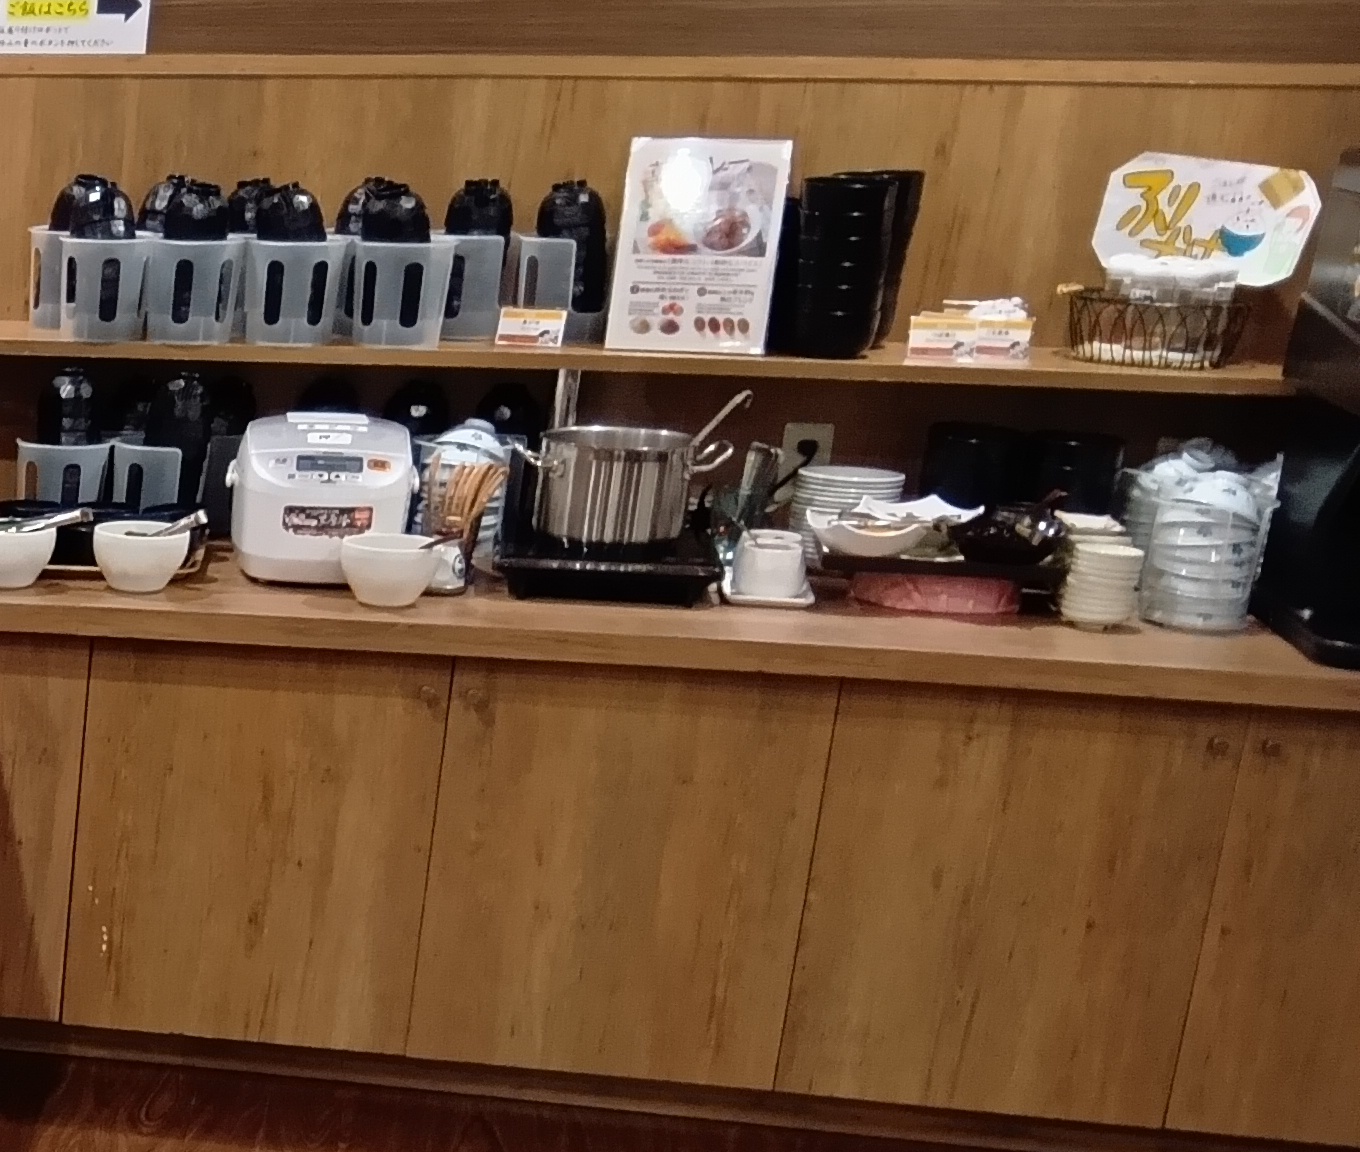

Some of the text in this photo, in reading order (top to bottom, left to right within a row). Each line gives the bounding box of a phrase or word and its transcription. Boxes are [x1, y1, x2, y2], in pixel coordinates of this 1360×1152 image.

[7, 1, 89, 17] ご飯はこちら
